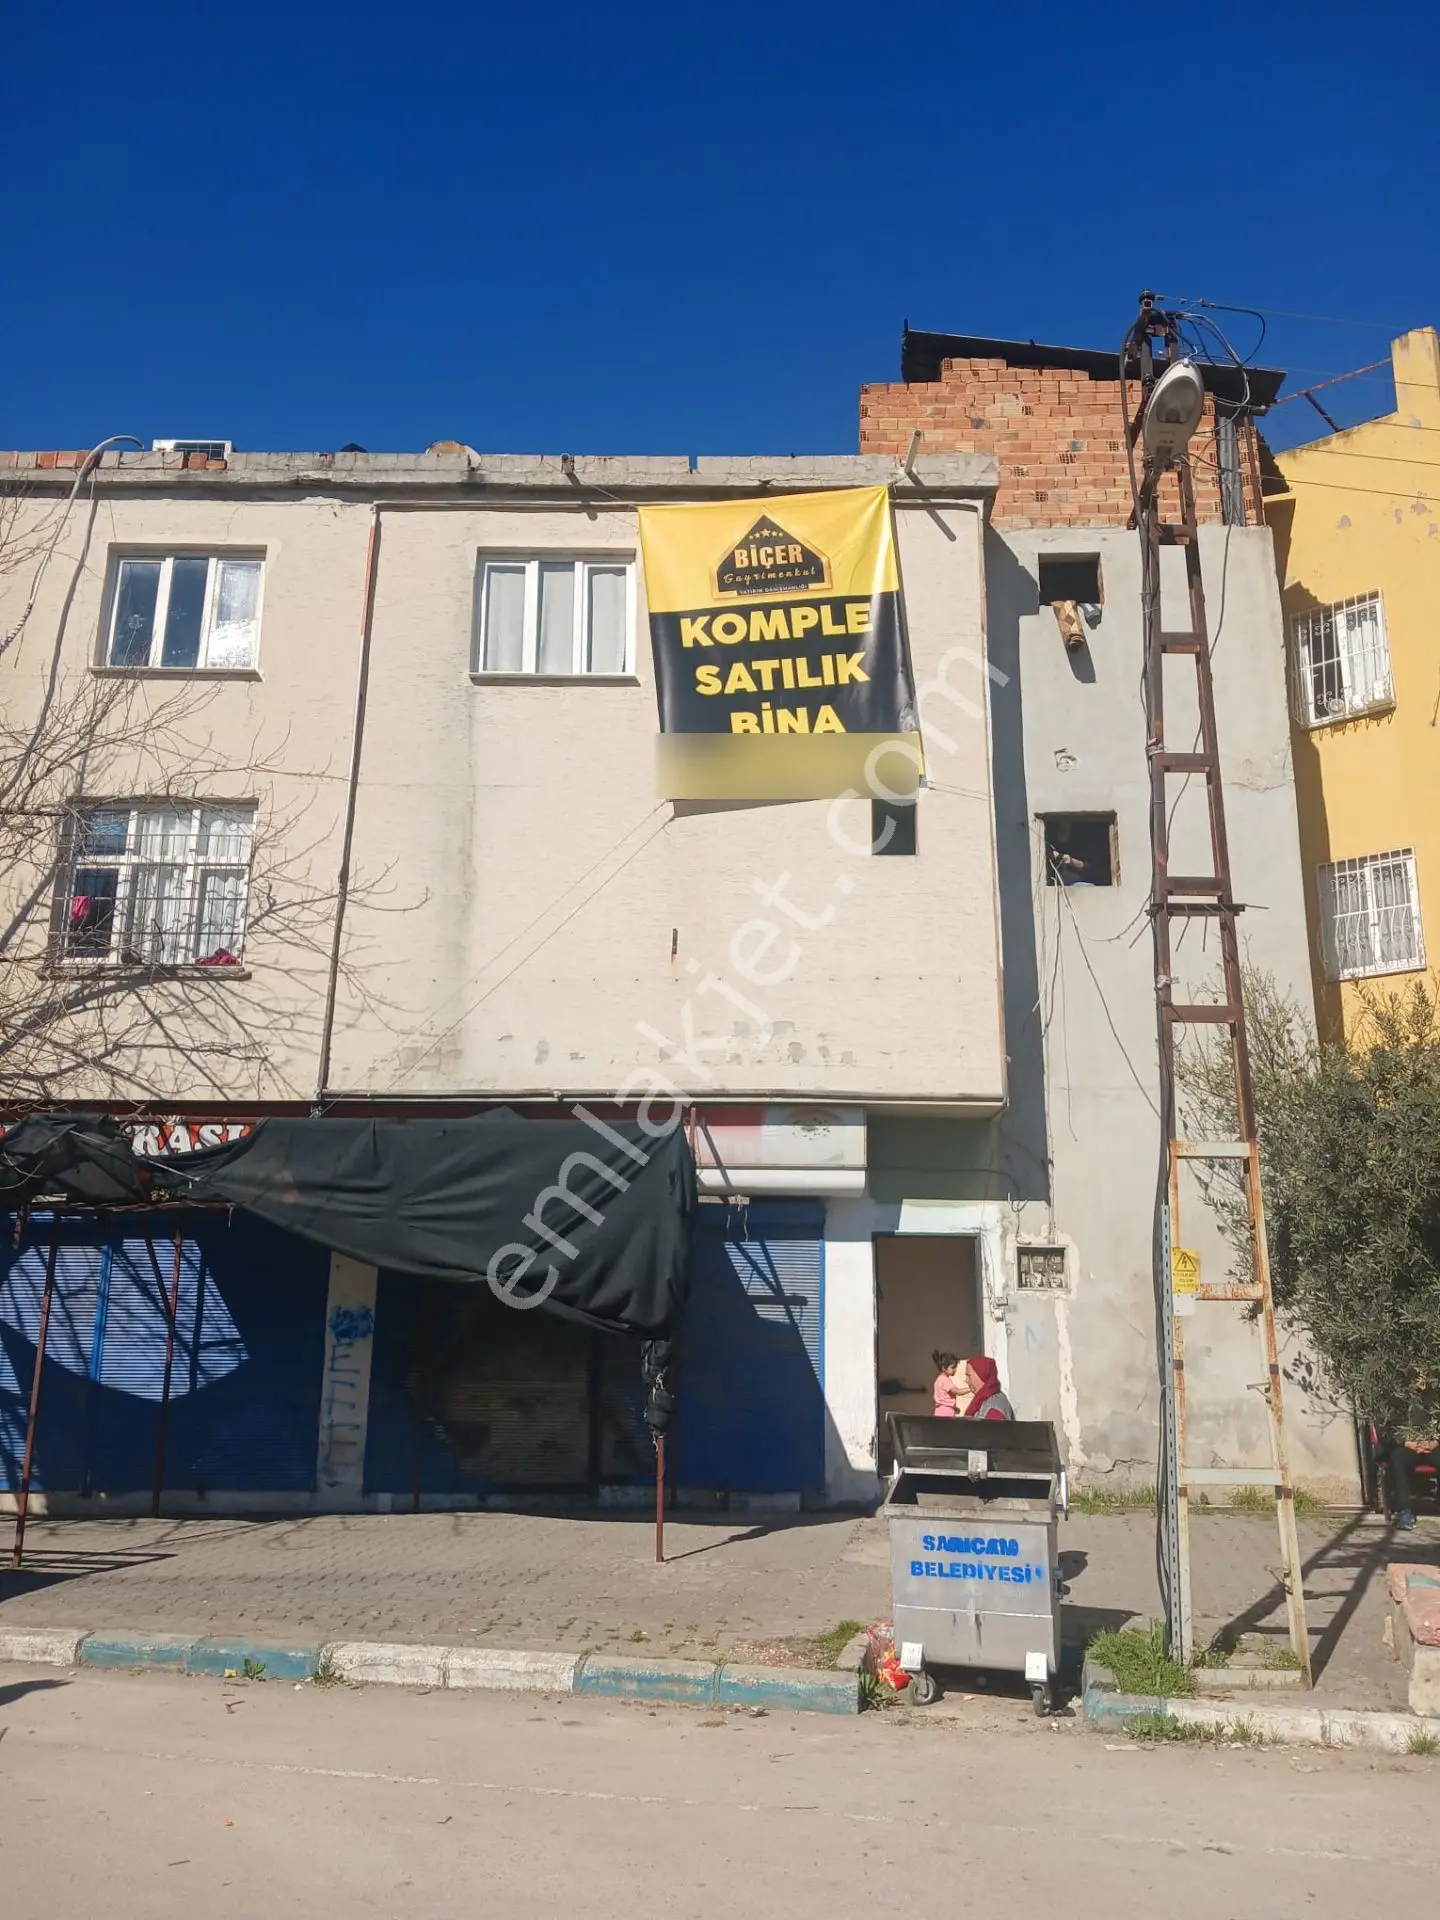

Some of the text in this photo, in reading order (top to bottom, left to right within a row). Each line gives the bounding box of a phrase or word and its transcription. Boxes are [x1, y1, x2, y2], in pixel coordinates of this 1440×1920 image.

[733, 543, 804, 569] BİÇER
[722, 566, 816, 585] Gayrimenkul
[679, 602, 875, 648] KOMPLE
[695, 652, 872, 696] SATILIK
[730, 702, 847, 734] BİNA
[910, 1561, 1032, 1584] BELEDİYESİ
